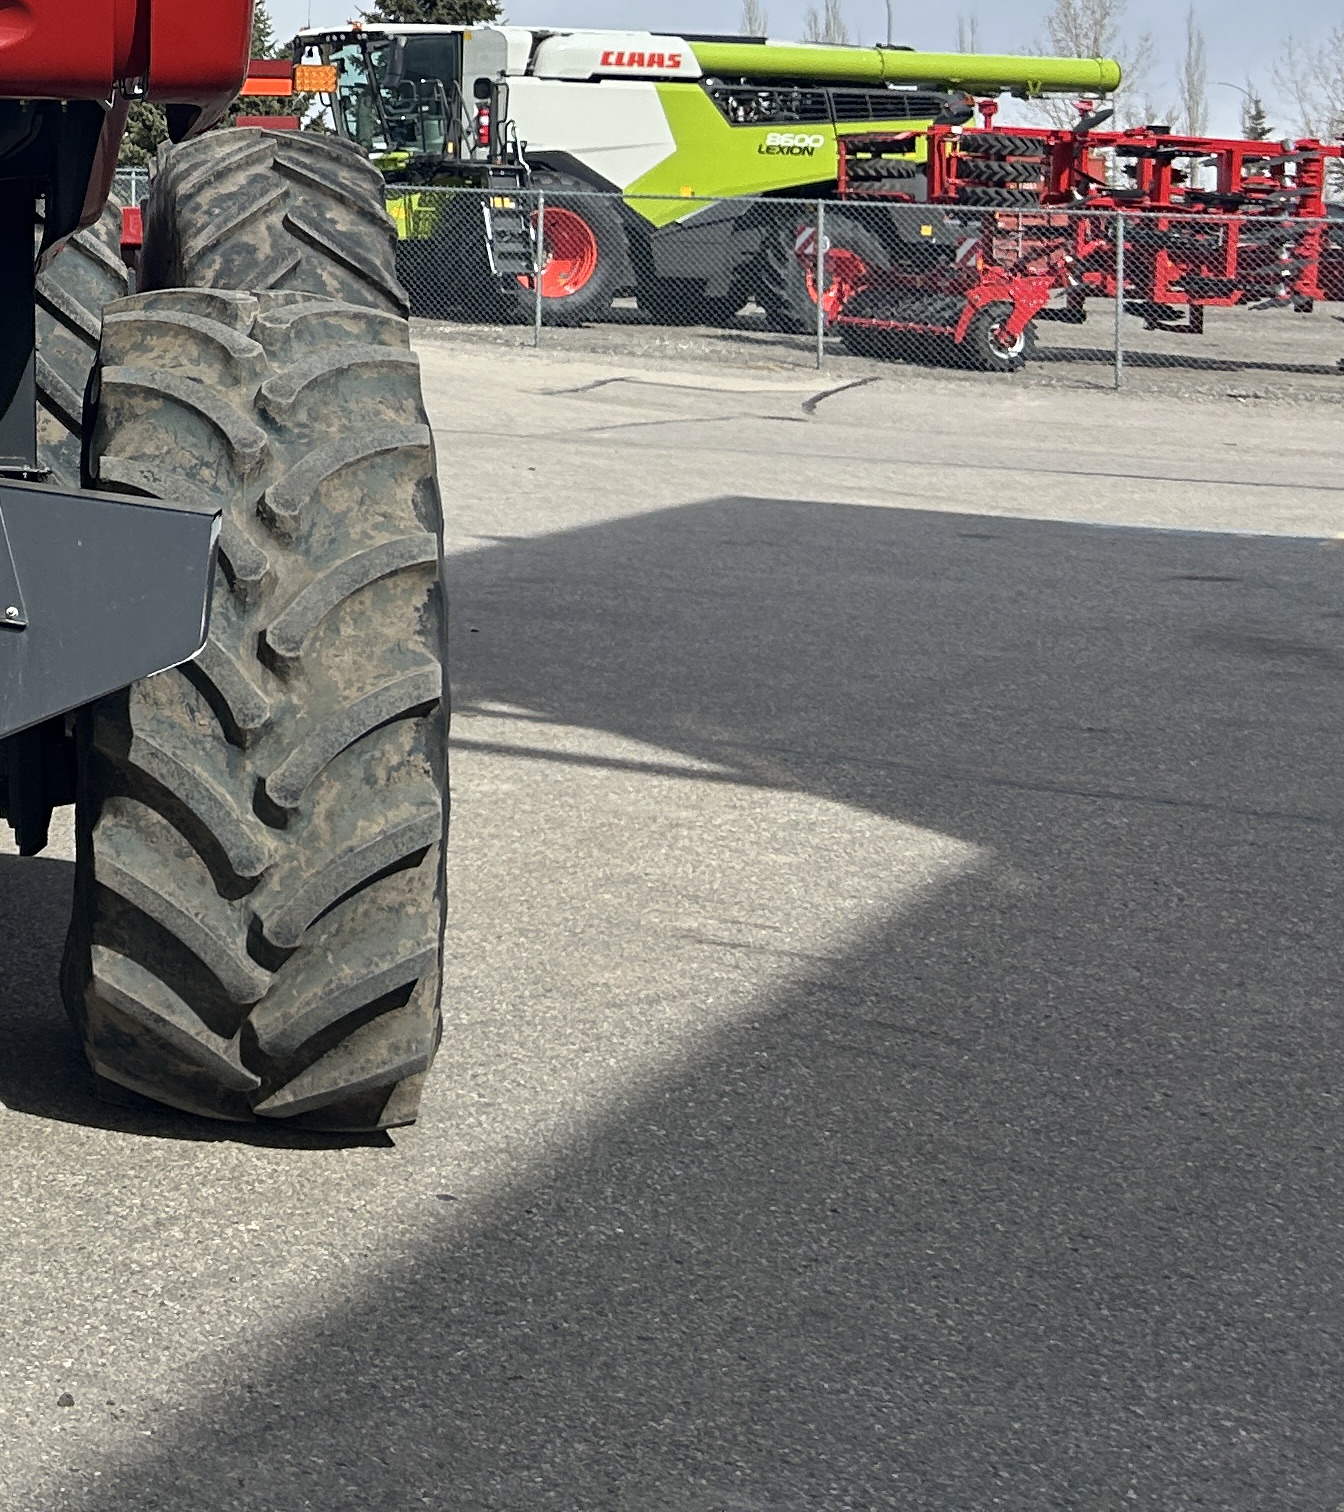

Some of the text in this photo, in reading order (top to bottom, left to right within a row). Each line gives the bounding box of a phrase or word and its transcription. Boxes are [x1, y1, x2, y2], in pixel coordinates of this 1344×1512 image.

[600, 51, 682, 68] CLAAS
[765, 132, 825, 148] 8600
[757, 144, 815, 157] LEXION
